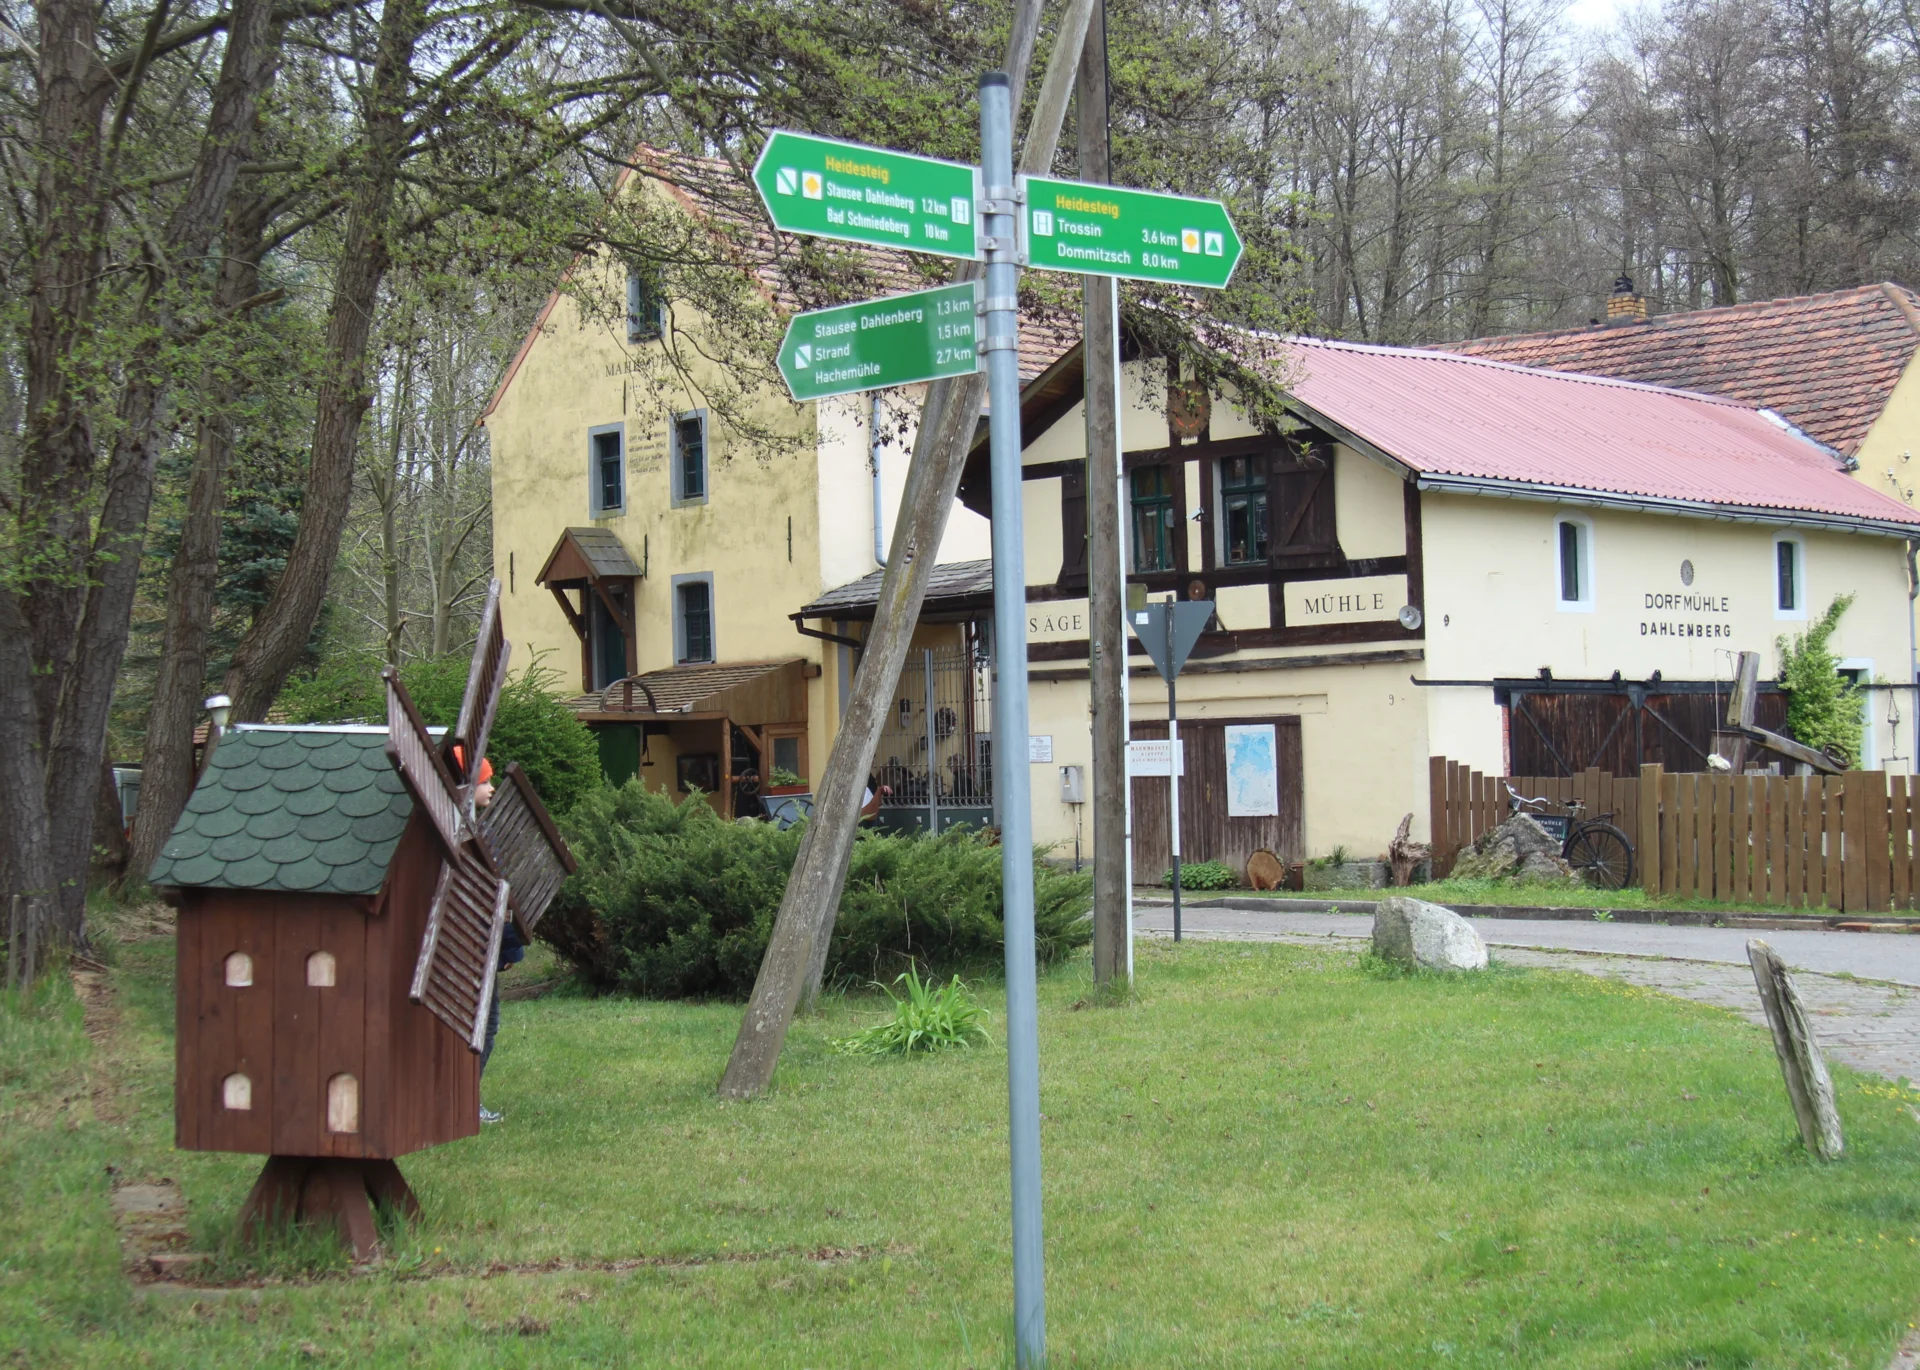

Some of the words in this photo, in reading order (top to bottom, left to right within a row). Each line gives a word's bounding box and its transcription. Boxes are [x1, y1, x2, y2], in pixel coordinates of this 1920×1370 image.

[825, 156, 890, 184] Heidesteig
[826, 182, 862, 201] Stausee
[865, 188, 915, 214] Dahlenberg
[1056, 195, 1119, 219] Heidesteig
[826, 207, 844, 224] Bad
[847, 213, 910, 239] Schmiedeberg
[924, 223, 935, 237] 10
[934, 225, 948, 241] km
[1057, 218, 1101, 237] Trossin
[1141, 228, 1159, 244] 3.6
[1159, 231, 1178, 246] km
[1057, 242, 1131, 264] Dommitzsch
[1142, 253, 1159, 268] 8.0
[1160, 255, 1179, 270] km
[814, 320, 857, 339] Stausee
[860, 308, 923, 330] Dahlenberg
[936, 301, 951, 317] 1.3
[952, 297, 970, 313] km
[815, 343, 850, 361] Strand
[937, 325, 951, 340] 1.5
[952, 321, 971, 337] km
[815, 362, 880, 385] Hachemühle
[936, 349, 952, 365] 2.7
[953, 345, 972, 361] km
[1029, 614, 1082, 633] SÄGE
[1304, 593, 1384, 615] MÜHLE
[1644, 591, 1729, 612] DORFMÜHLE
[1640, 622, 1731, 638] DAHLENBERG
[1388, 694, 1394, 706] 9
